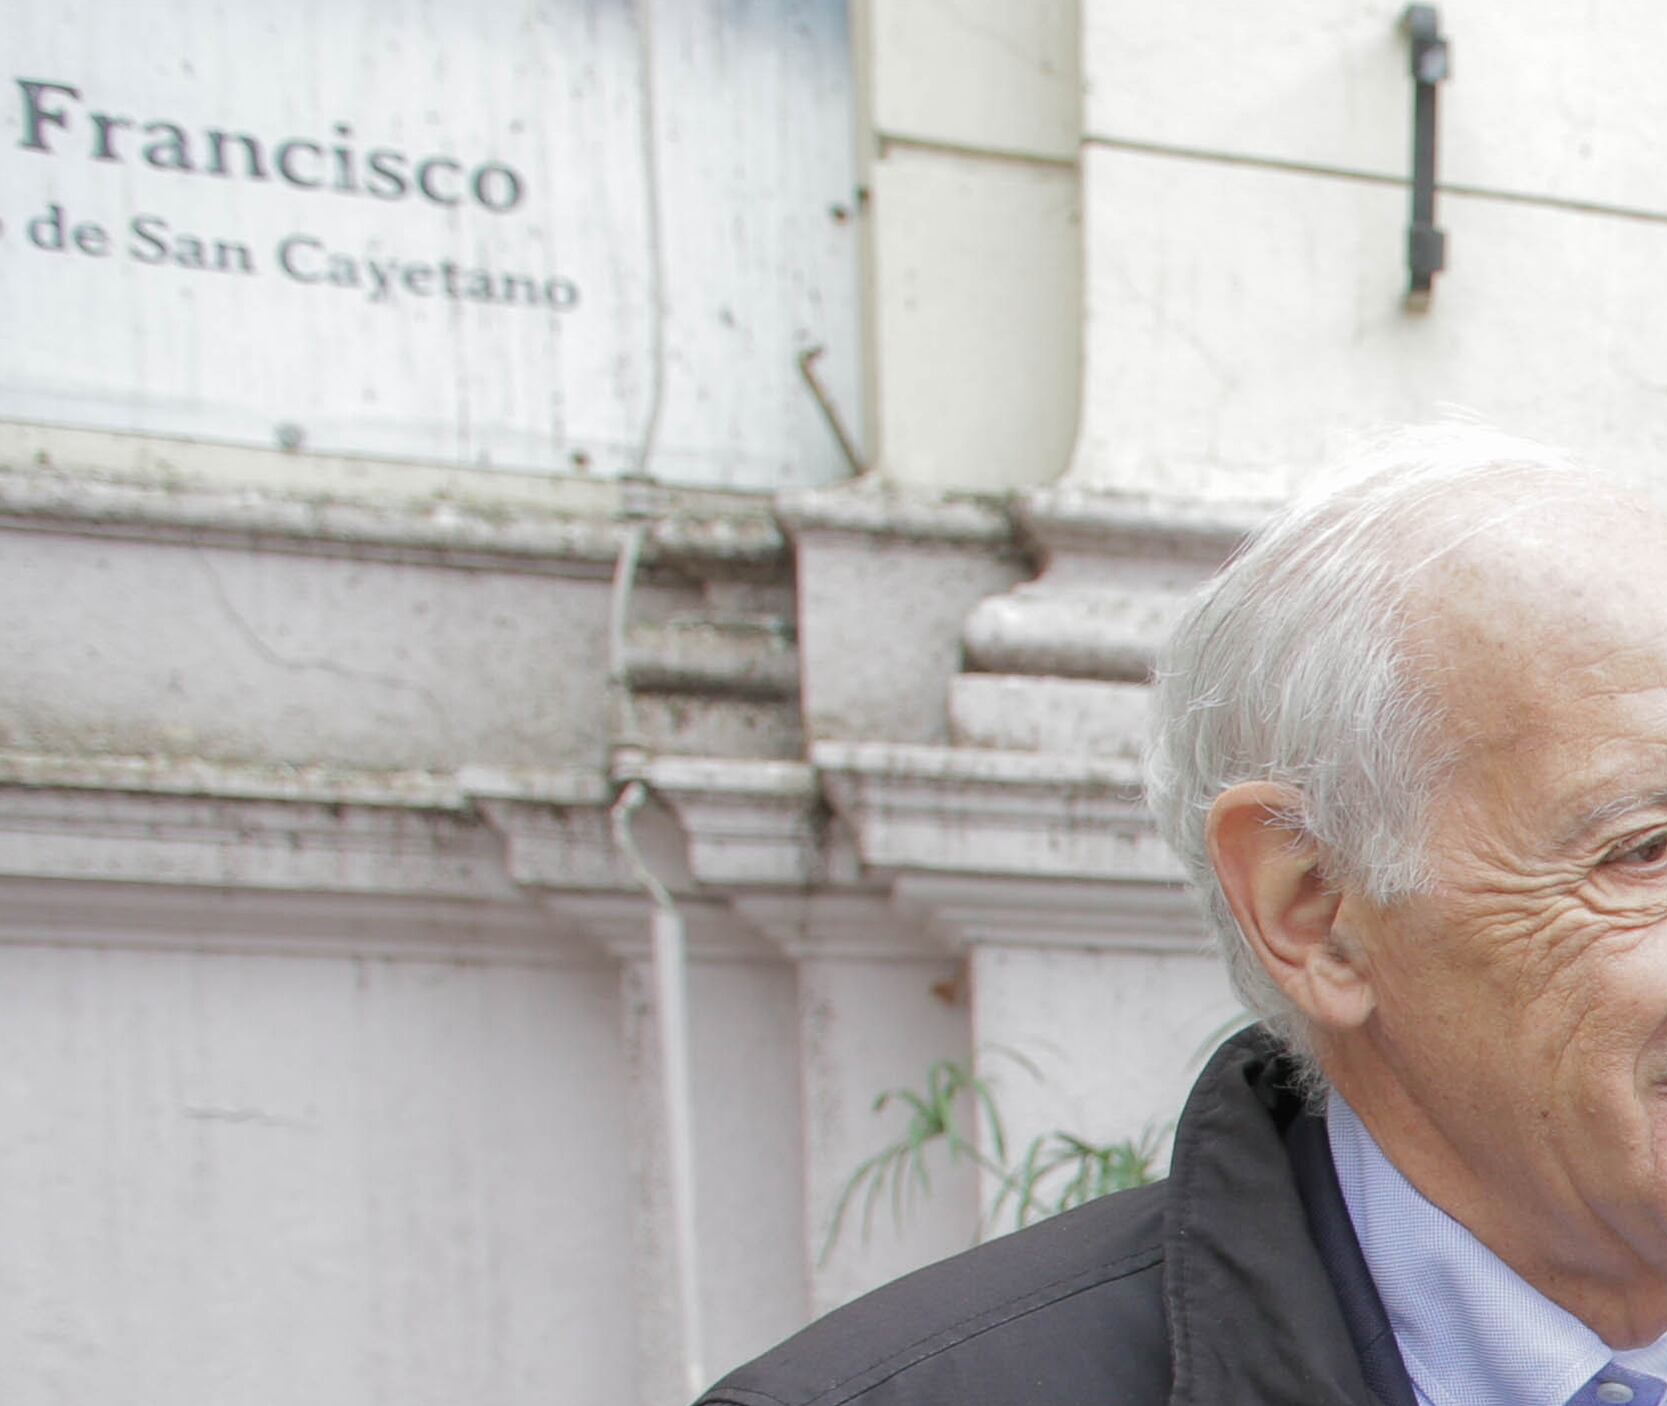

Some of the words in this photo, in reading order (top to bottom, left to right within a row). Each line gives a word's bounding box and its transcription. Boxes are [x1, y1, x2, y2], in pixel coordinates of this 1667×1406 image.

[16, 77, 523, 213] Francisco
[27, 201, 111, 257] de
[128, 214, 257, 274] San
[275, 234, 580, 312] Cayetano
